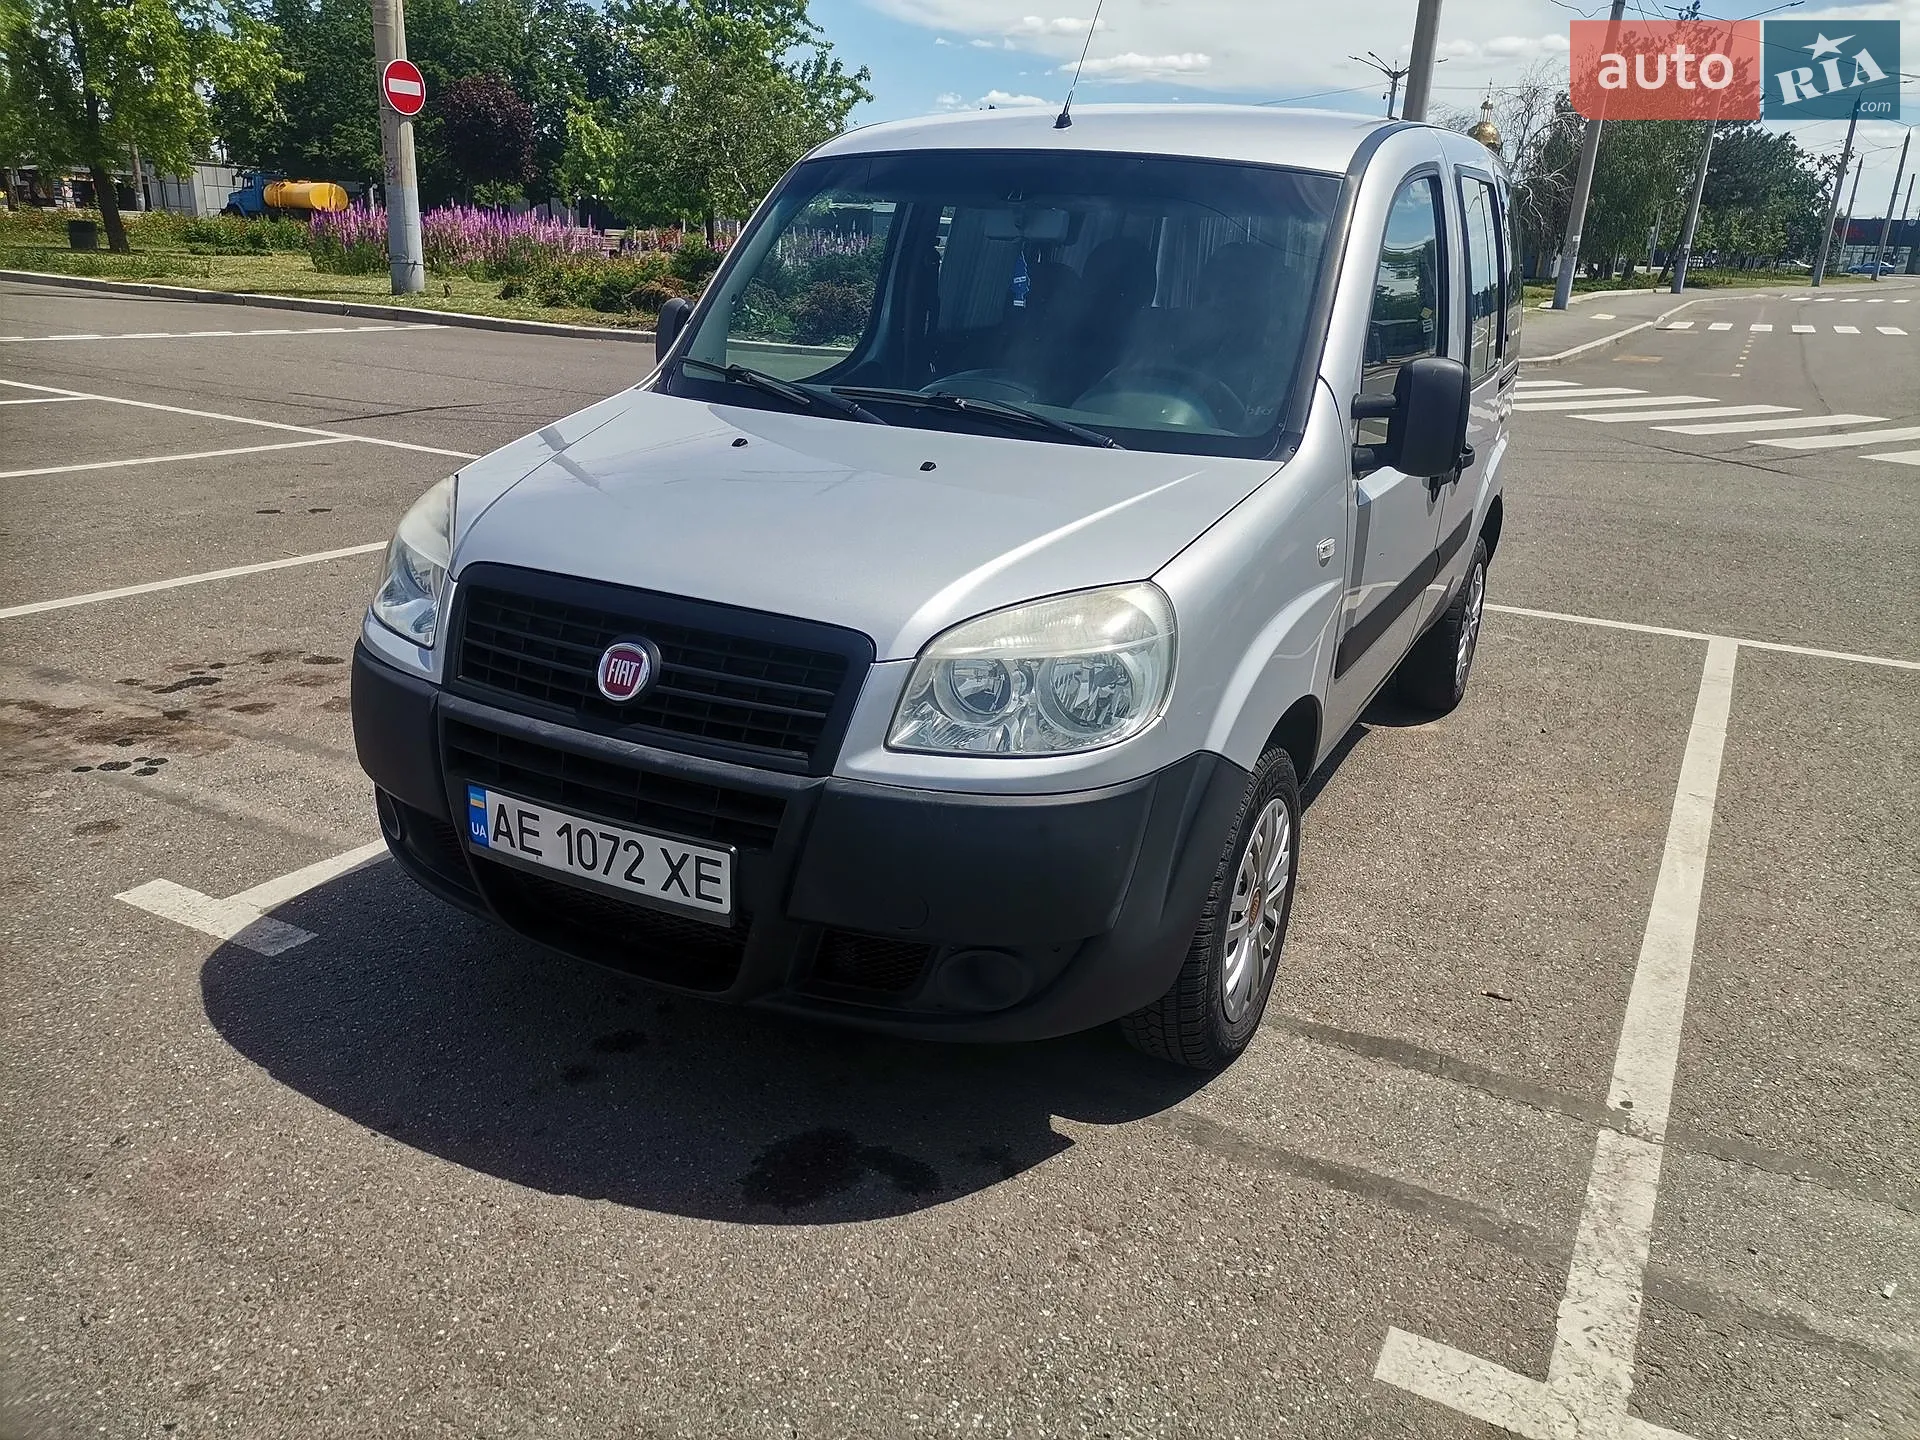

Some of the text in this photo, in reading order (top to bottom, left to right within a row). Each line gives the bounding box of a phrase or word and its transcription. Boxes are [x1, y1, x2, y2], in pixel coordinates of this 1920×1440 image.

[607, 658, 639, 687] FIAT
[471, 822, 487, 838] UA
[492, 803, 724, 905] AE 1072 XE
